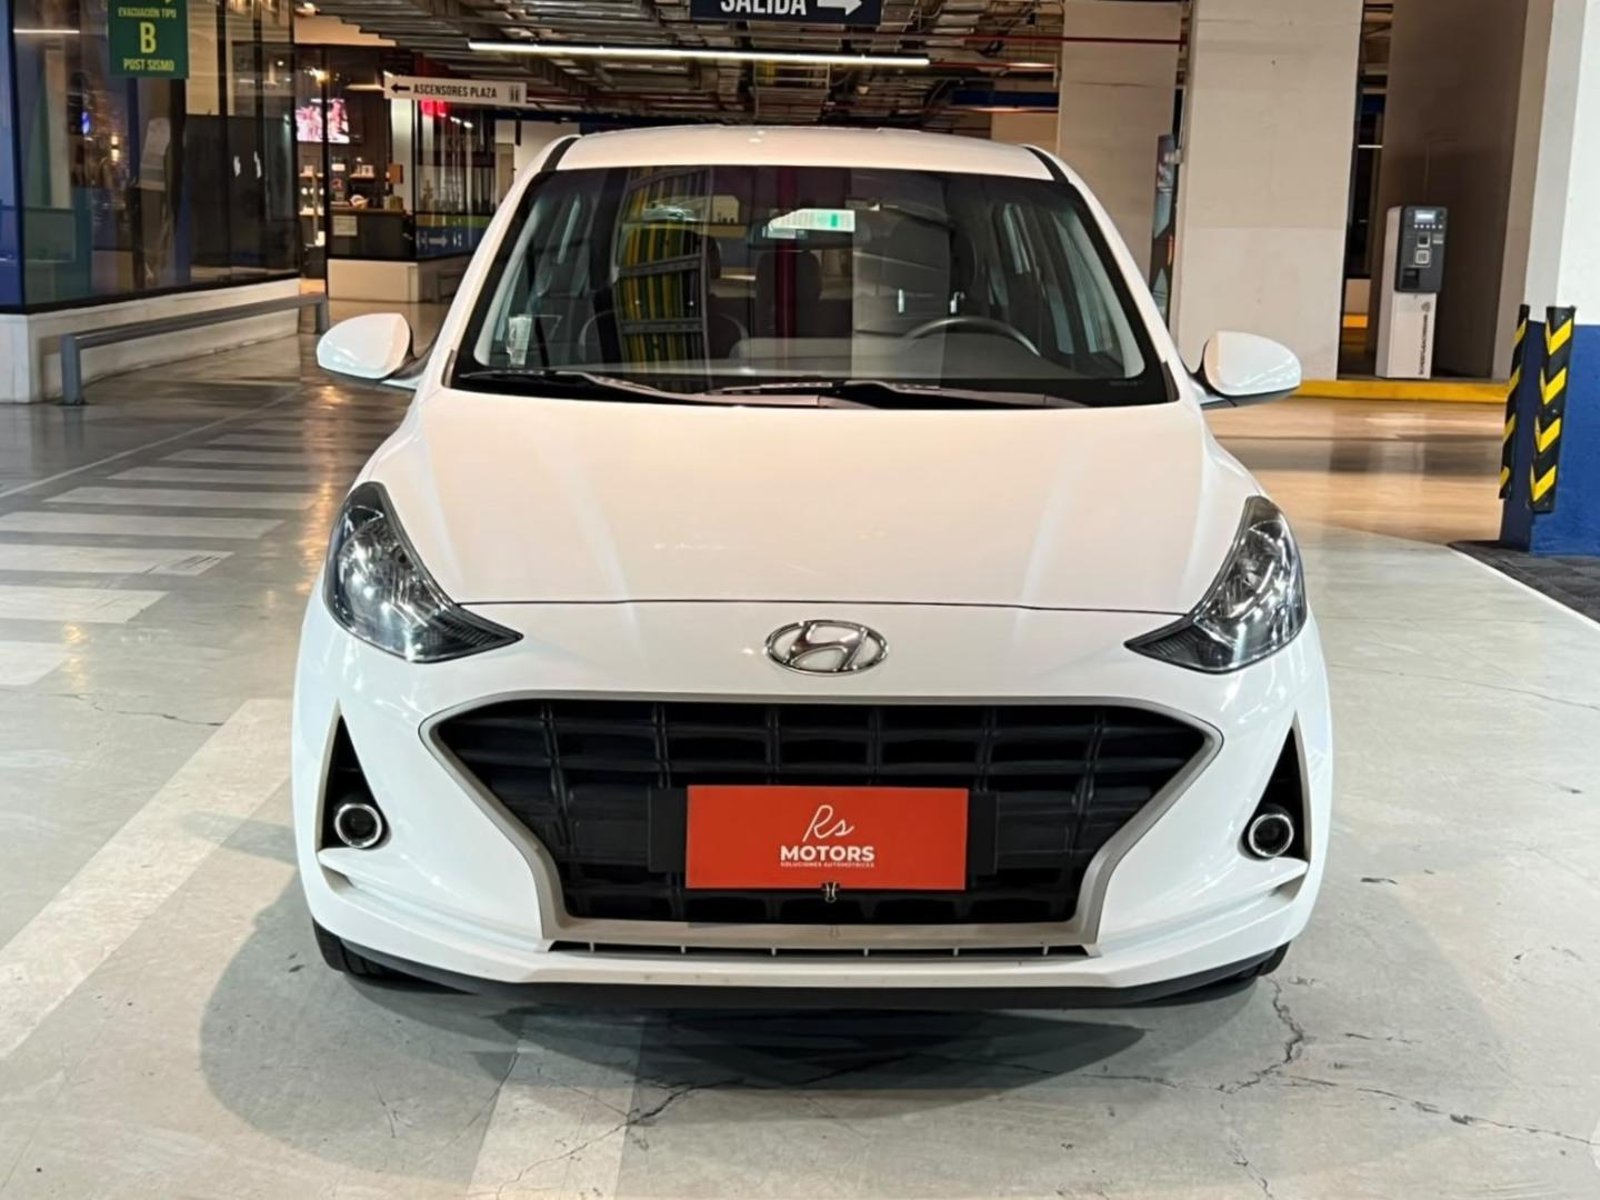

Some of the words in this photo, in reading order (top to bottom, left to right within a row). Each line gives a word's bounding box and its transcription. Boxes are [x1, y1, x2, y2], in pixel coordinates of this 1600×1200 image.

[161, 7, 177, 19] TIPO
[720, 0, 807, 16] SALIDA
[139, 21, 157, 54] B
[123, 58, 146, 71] POST
[146, 58, 175, 72] SISMO
[413, 83, 469, 98] ASCENSORES
[469, 86, 498, 99] PLAZA
[802, 804, 855, 842] Rs
[780, 845, 876, 862] MOTORS
